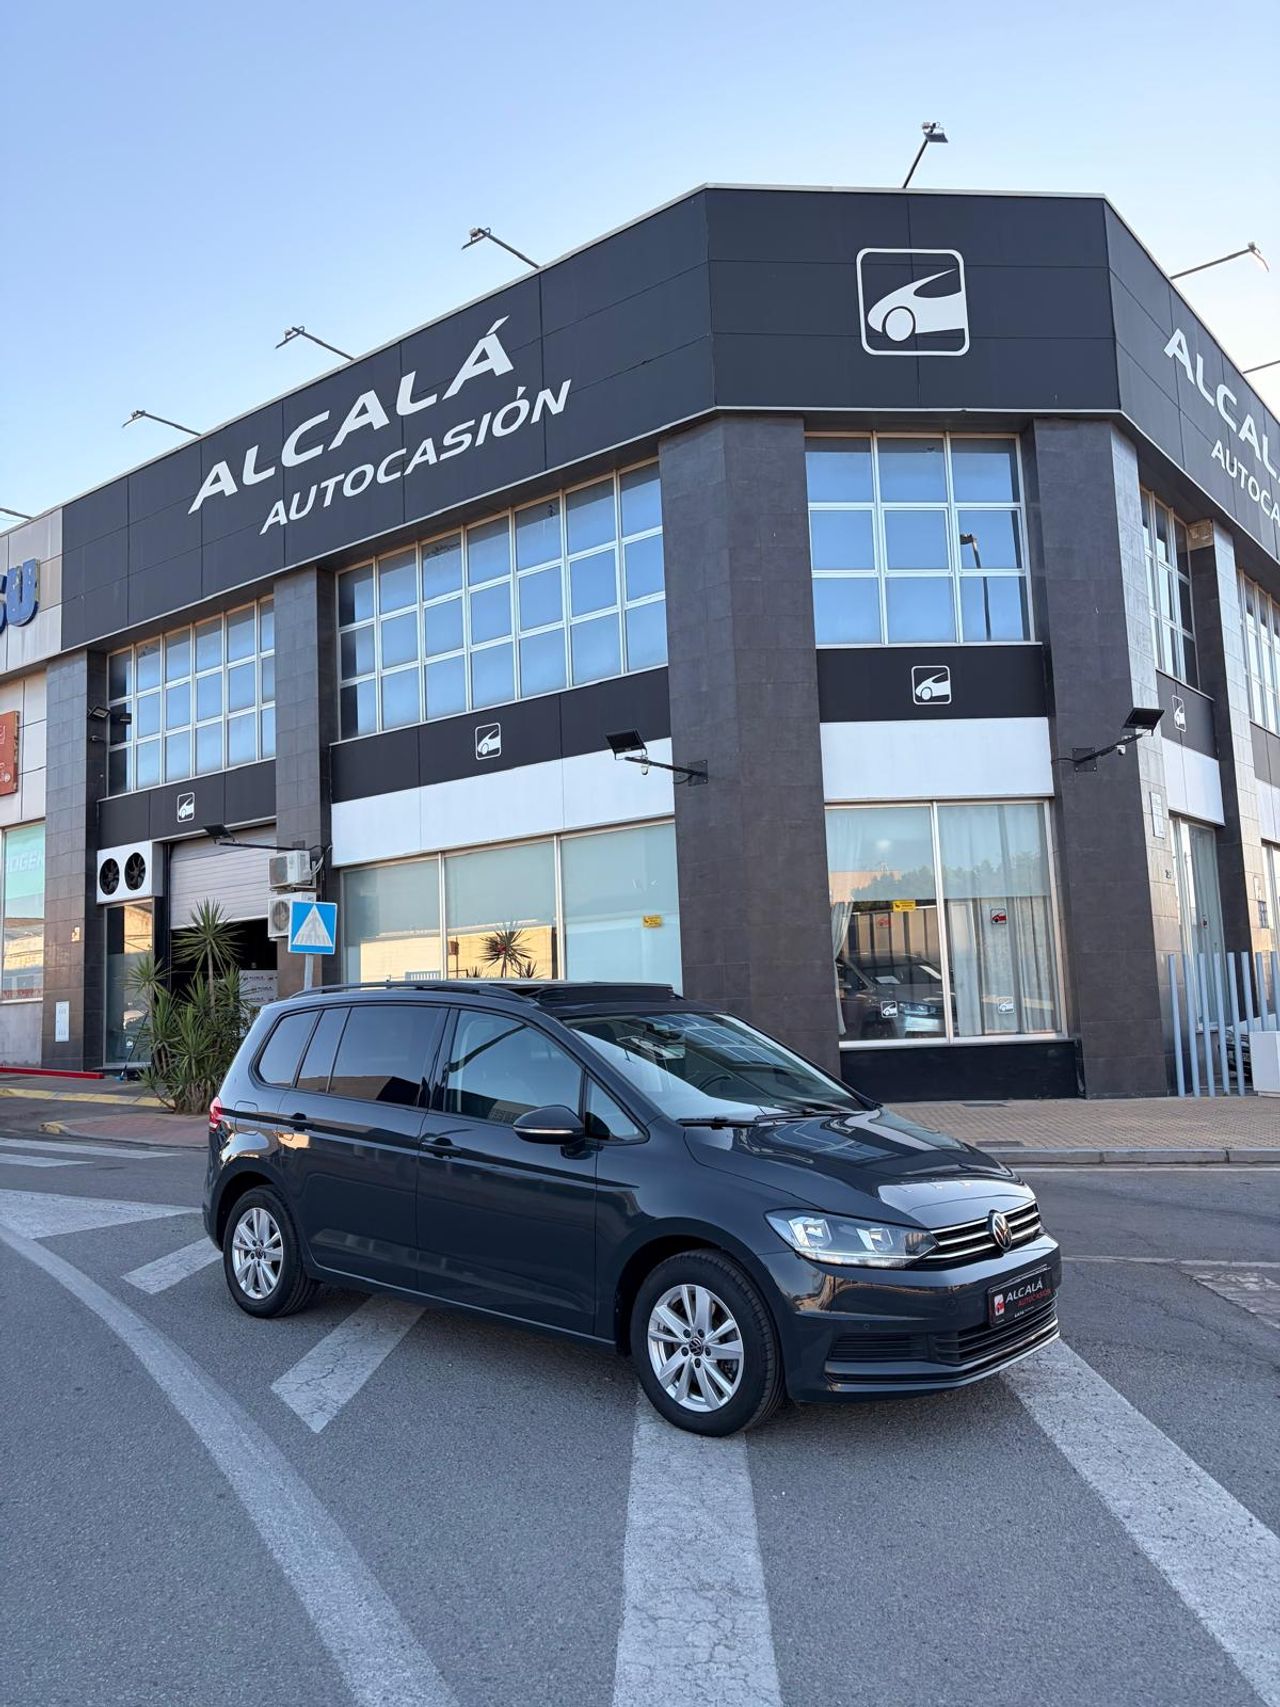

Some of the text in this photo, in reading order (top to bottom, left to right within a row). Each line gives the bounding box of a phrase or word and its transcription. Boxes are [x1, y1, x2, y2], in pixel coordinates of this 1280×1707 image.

[187, 314, 514, 515] ALCALÁ
[259, 379, 572, 535] AUTOCASIÓN
[1163, 328, 1280, 484] ALCAL
